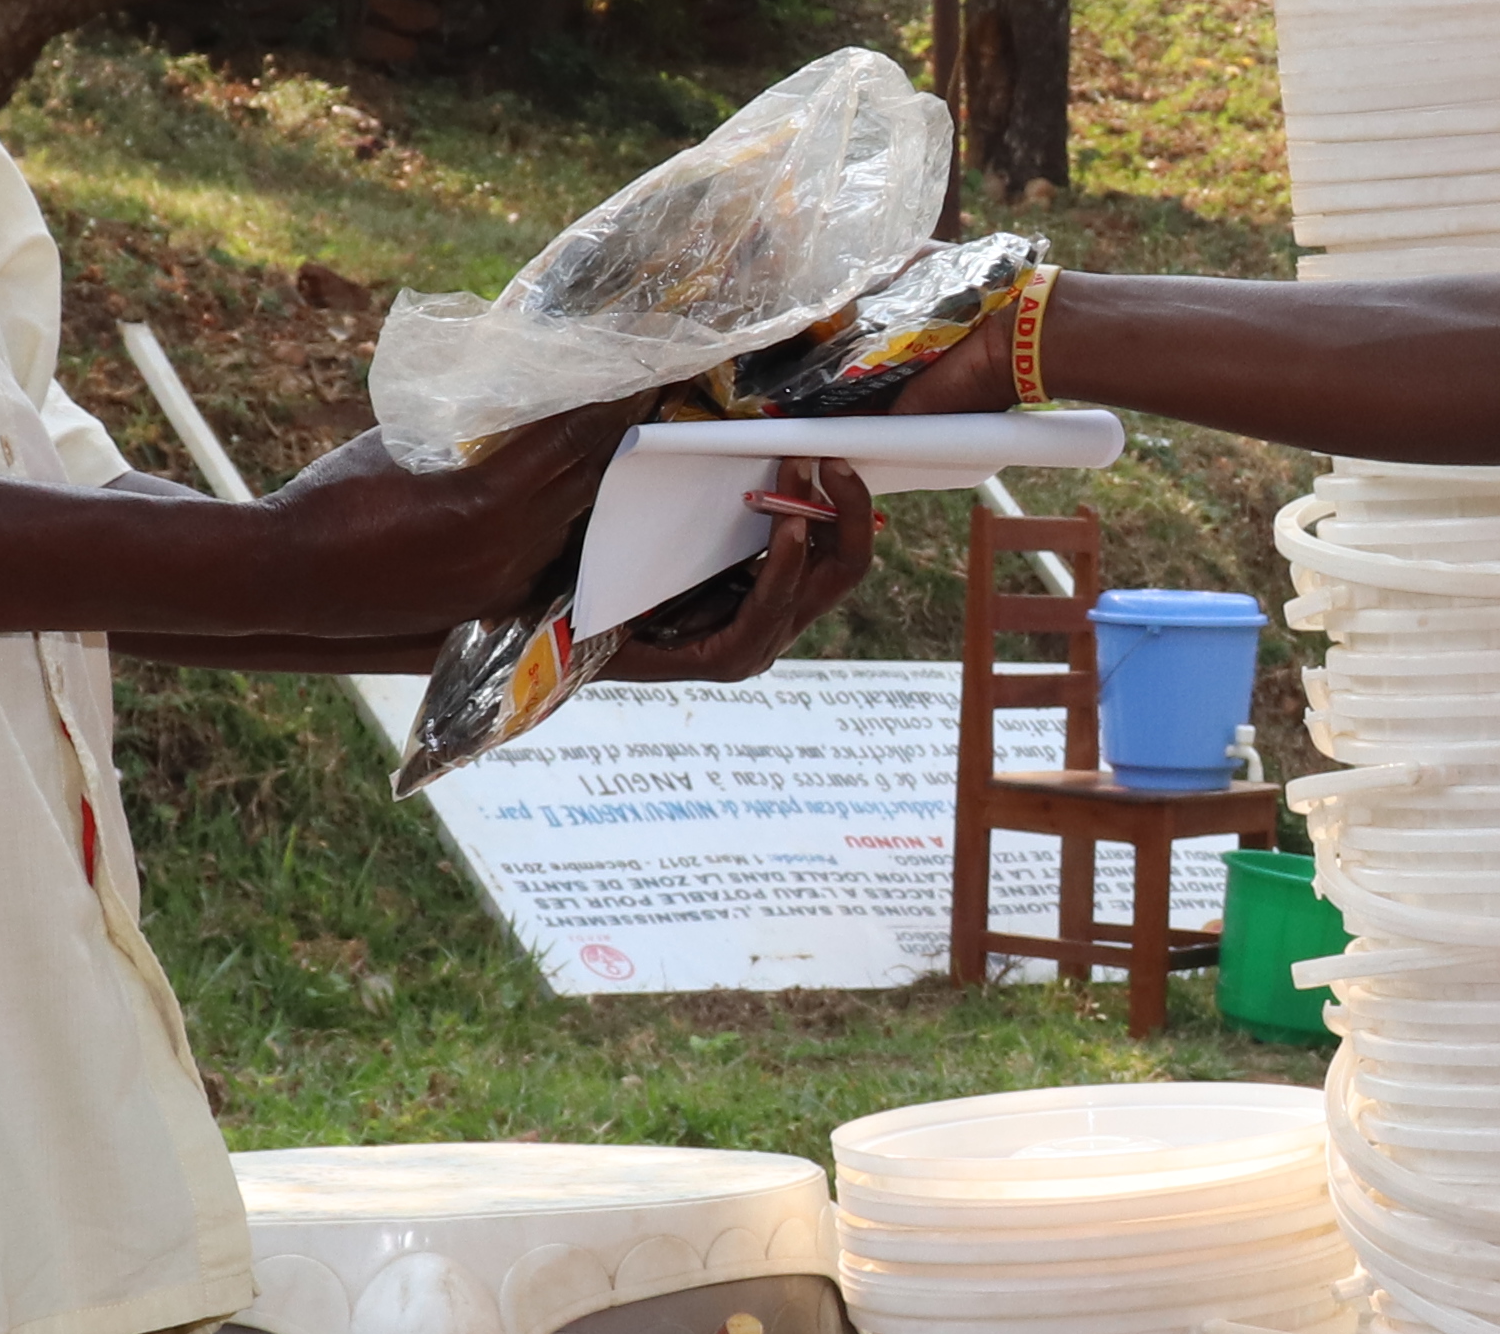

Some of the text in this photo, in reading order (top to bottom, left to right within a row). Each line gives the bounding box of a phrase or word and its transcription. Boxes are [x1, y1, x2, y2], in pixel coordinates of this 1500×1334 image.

[1013, 295, 1042, 403] ADIDAS
[684, 687, 773, 710] bornes
[776, 691, 813, 711] des
[836, 717, 933, 737] conduite
[602, 744, 620, 764] et
[625, 743, 700, 761] ventouse
[701, 743, 720, 762] de
[725, 743, 794, 764] chambre
[830, 744, 925, 765] collectrice
[578, 771, 693, 795] ANGUTI
[706, 771, 726, 791] à
[731, 771, 784, 791] d'eau
[793, 772, 869, 787] sources
[875, 773, 891, 792] 6
[893, 772, 917, 791] de
[495, 799, 533, 821] par
[717, 799, 739, 819] de
[742, 795, 803, 819] potable
[843, 835, 944, 848] A NUNDU
[658, 856, 702, 869] 2017
[704, 855, 749, 866] Mars
[752, 855, 763, 865] 1
[992, 851, 1023, 863] FIZI
[1028, 850, 1055, 862] DE
[500, 863, 546, 875] 2018
[549, 859, 642, 874] Décembre
[693, 873, 723, 885] LA
[727, 871, 785, 883] DANS
[789, 871, 871, 883] LOCALE
[1009, 869, 1035, 880] LA
[513, 880, 588, 892] SANTE
[592, 879, 623, 890] DE
[627, 875, 691, 889] ZONE
[658, 888, 766, 905] POTABLE
[772, 888, 838, 900] L'EAU
[840, 888, 857, 899] A
[534, 897, 581, 909] LES
[585, 895, 653, 908] POUR
[759, 906, 833, 917] SANTE
[836, 905, 868, 916] DE
[871, 906, 936, 917] SOINS
